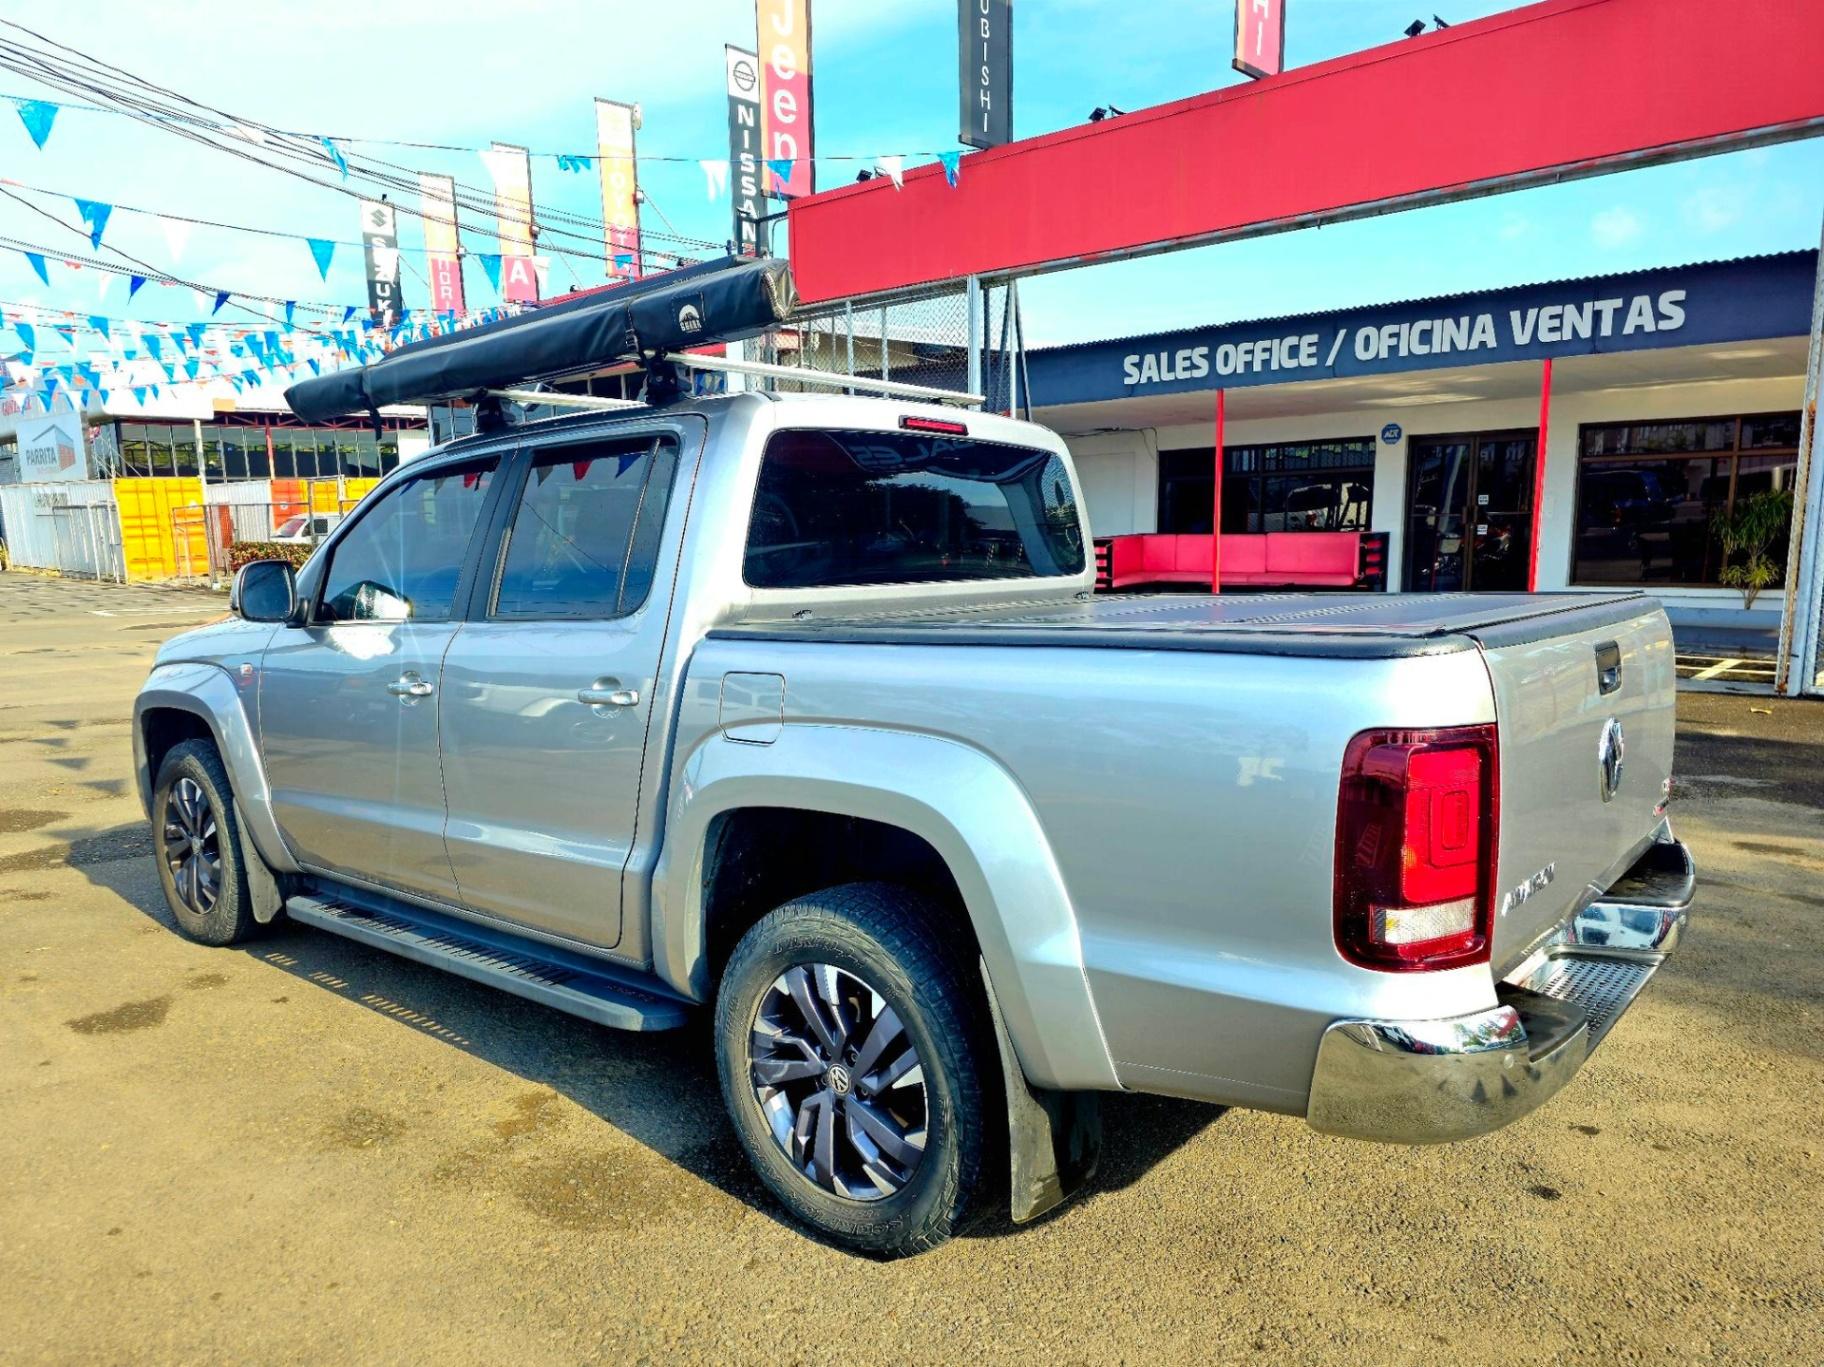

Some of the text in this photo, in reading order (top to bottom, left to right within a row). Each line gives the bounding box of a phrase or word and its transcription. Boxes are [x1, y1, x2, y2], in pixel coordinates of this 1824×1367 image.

[737, 103, 757, 242] NISSAN
[1123, 289, 1686, 385] SALES OFFICE / OFICINA VENTAS
[25, 446, 58, 466] PARRITA
